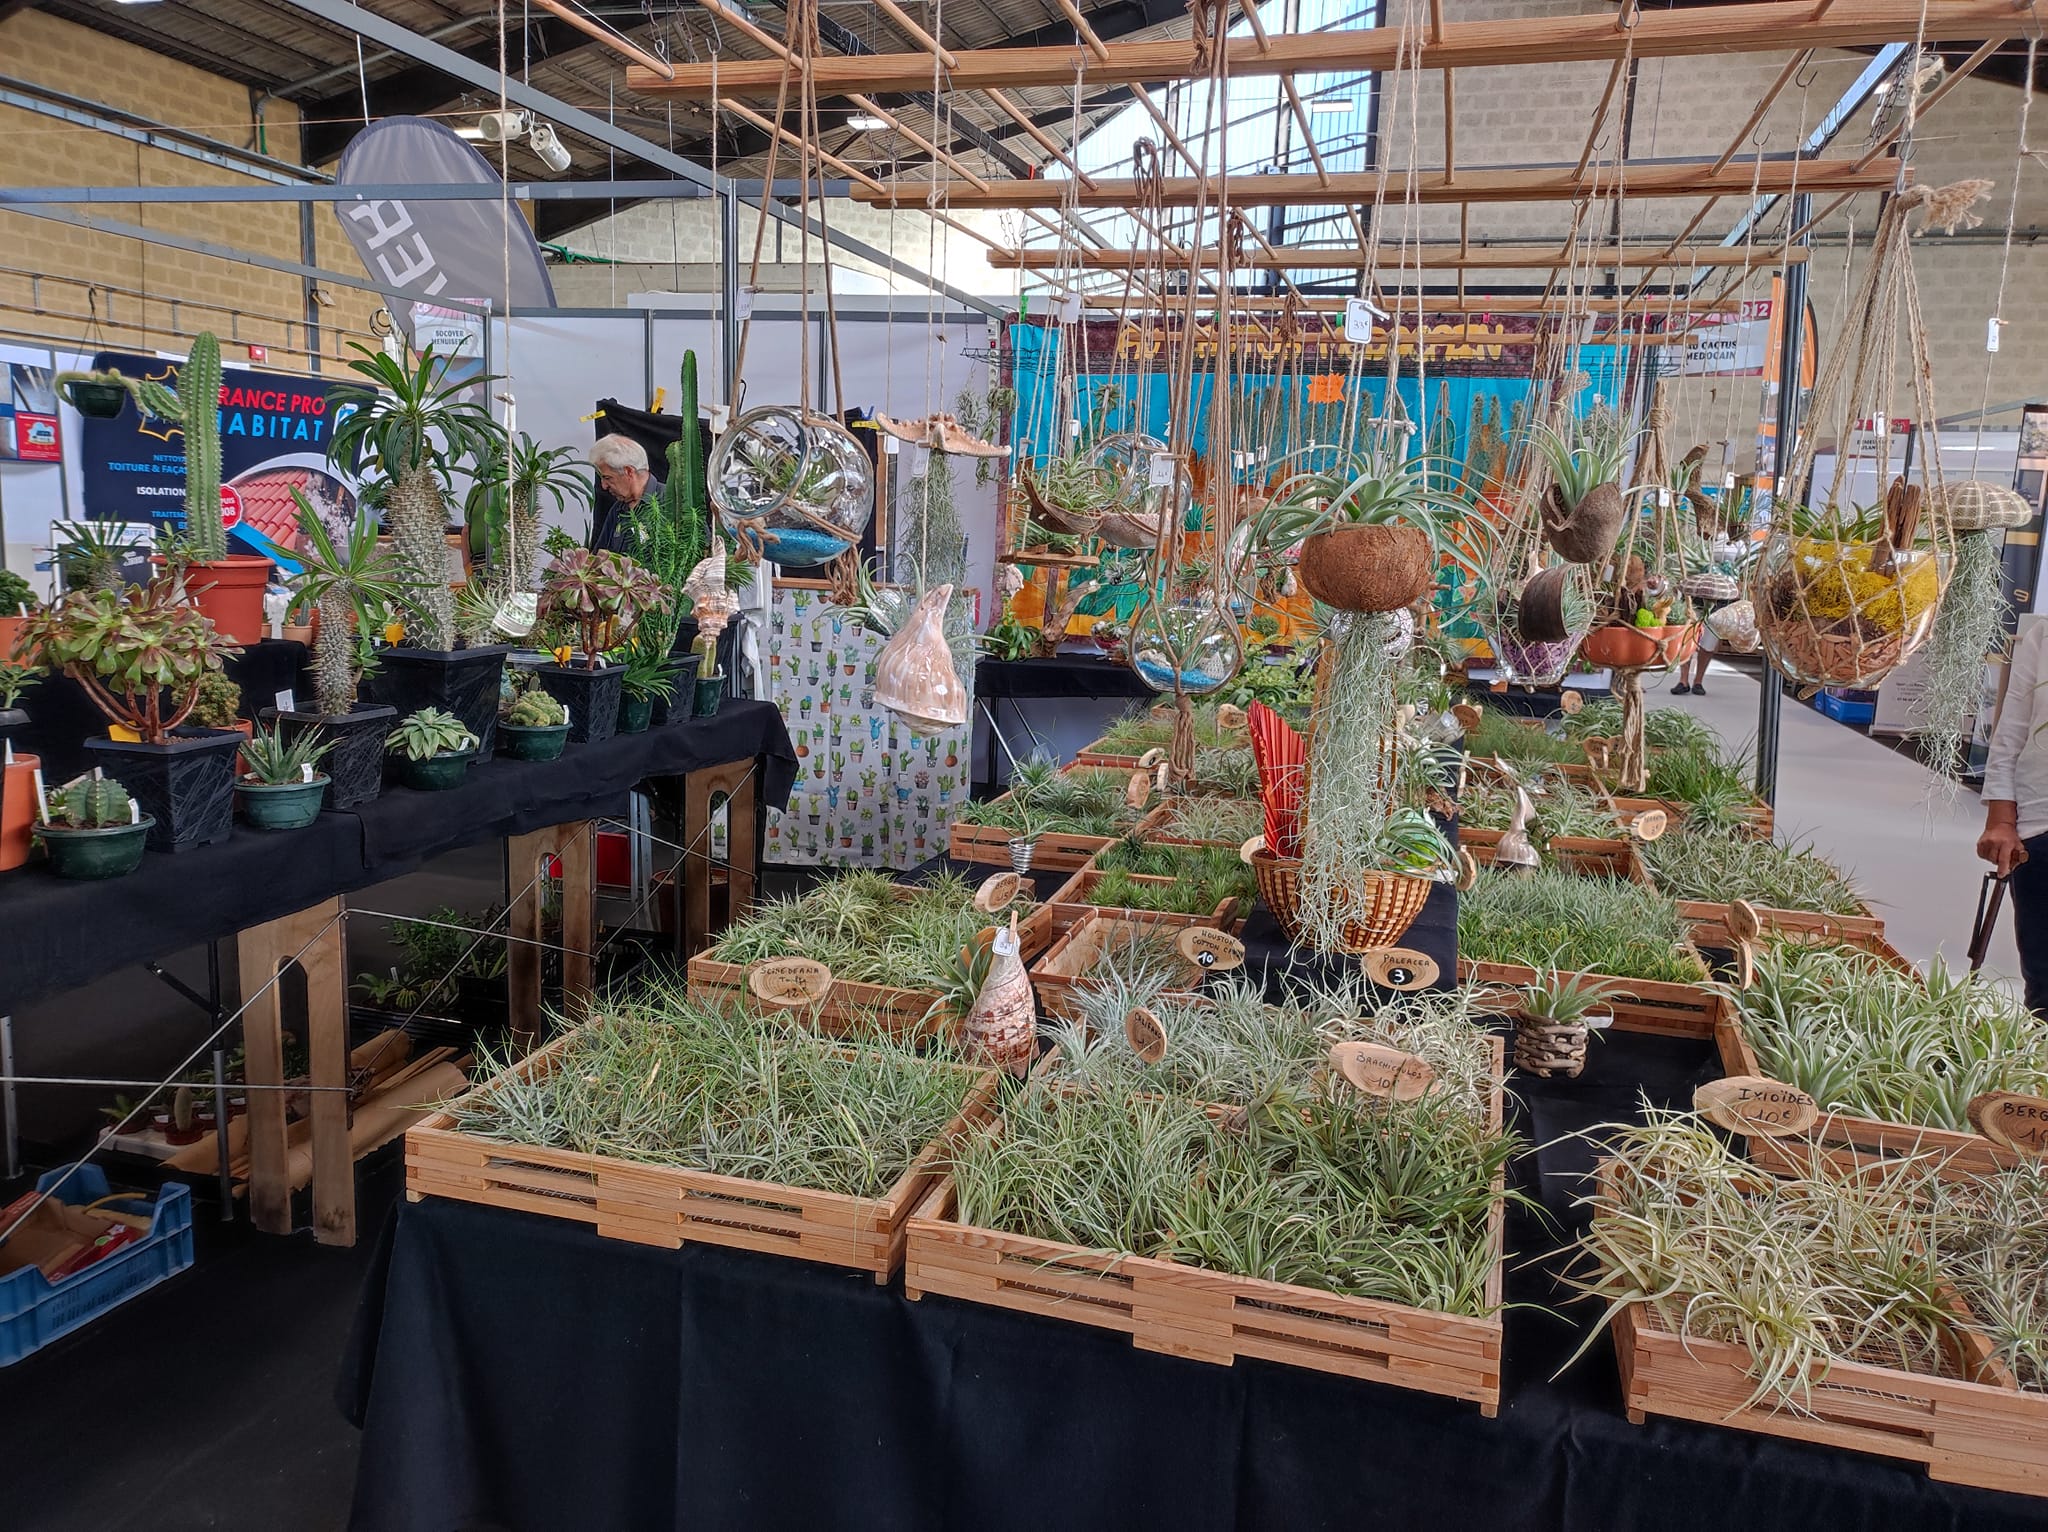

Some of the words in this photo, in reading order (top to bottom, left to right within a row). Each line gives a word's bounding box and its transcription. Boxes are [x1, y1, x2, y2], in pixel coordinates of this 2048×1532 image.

[1701, 341, 1737, 350] CACTUS
[1686, 352, 1736, 360] MEDOCAIN
[217, 385, 287, 412] RANCE
[290, 394, 327, 416] PRO
[107, 462, 151, 473] TOITURE
[152, 464, 160, 473] &
[136, 486, 187, 497] ISOLATION
[1191, 936, 1220, 951] COTTON
[1201, 930, 1235, 946] HOUSTON
[1383, 953, 1430, 967] PALEACEA
[1356, 1051, 1422, 1079] BRACHICULOS
